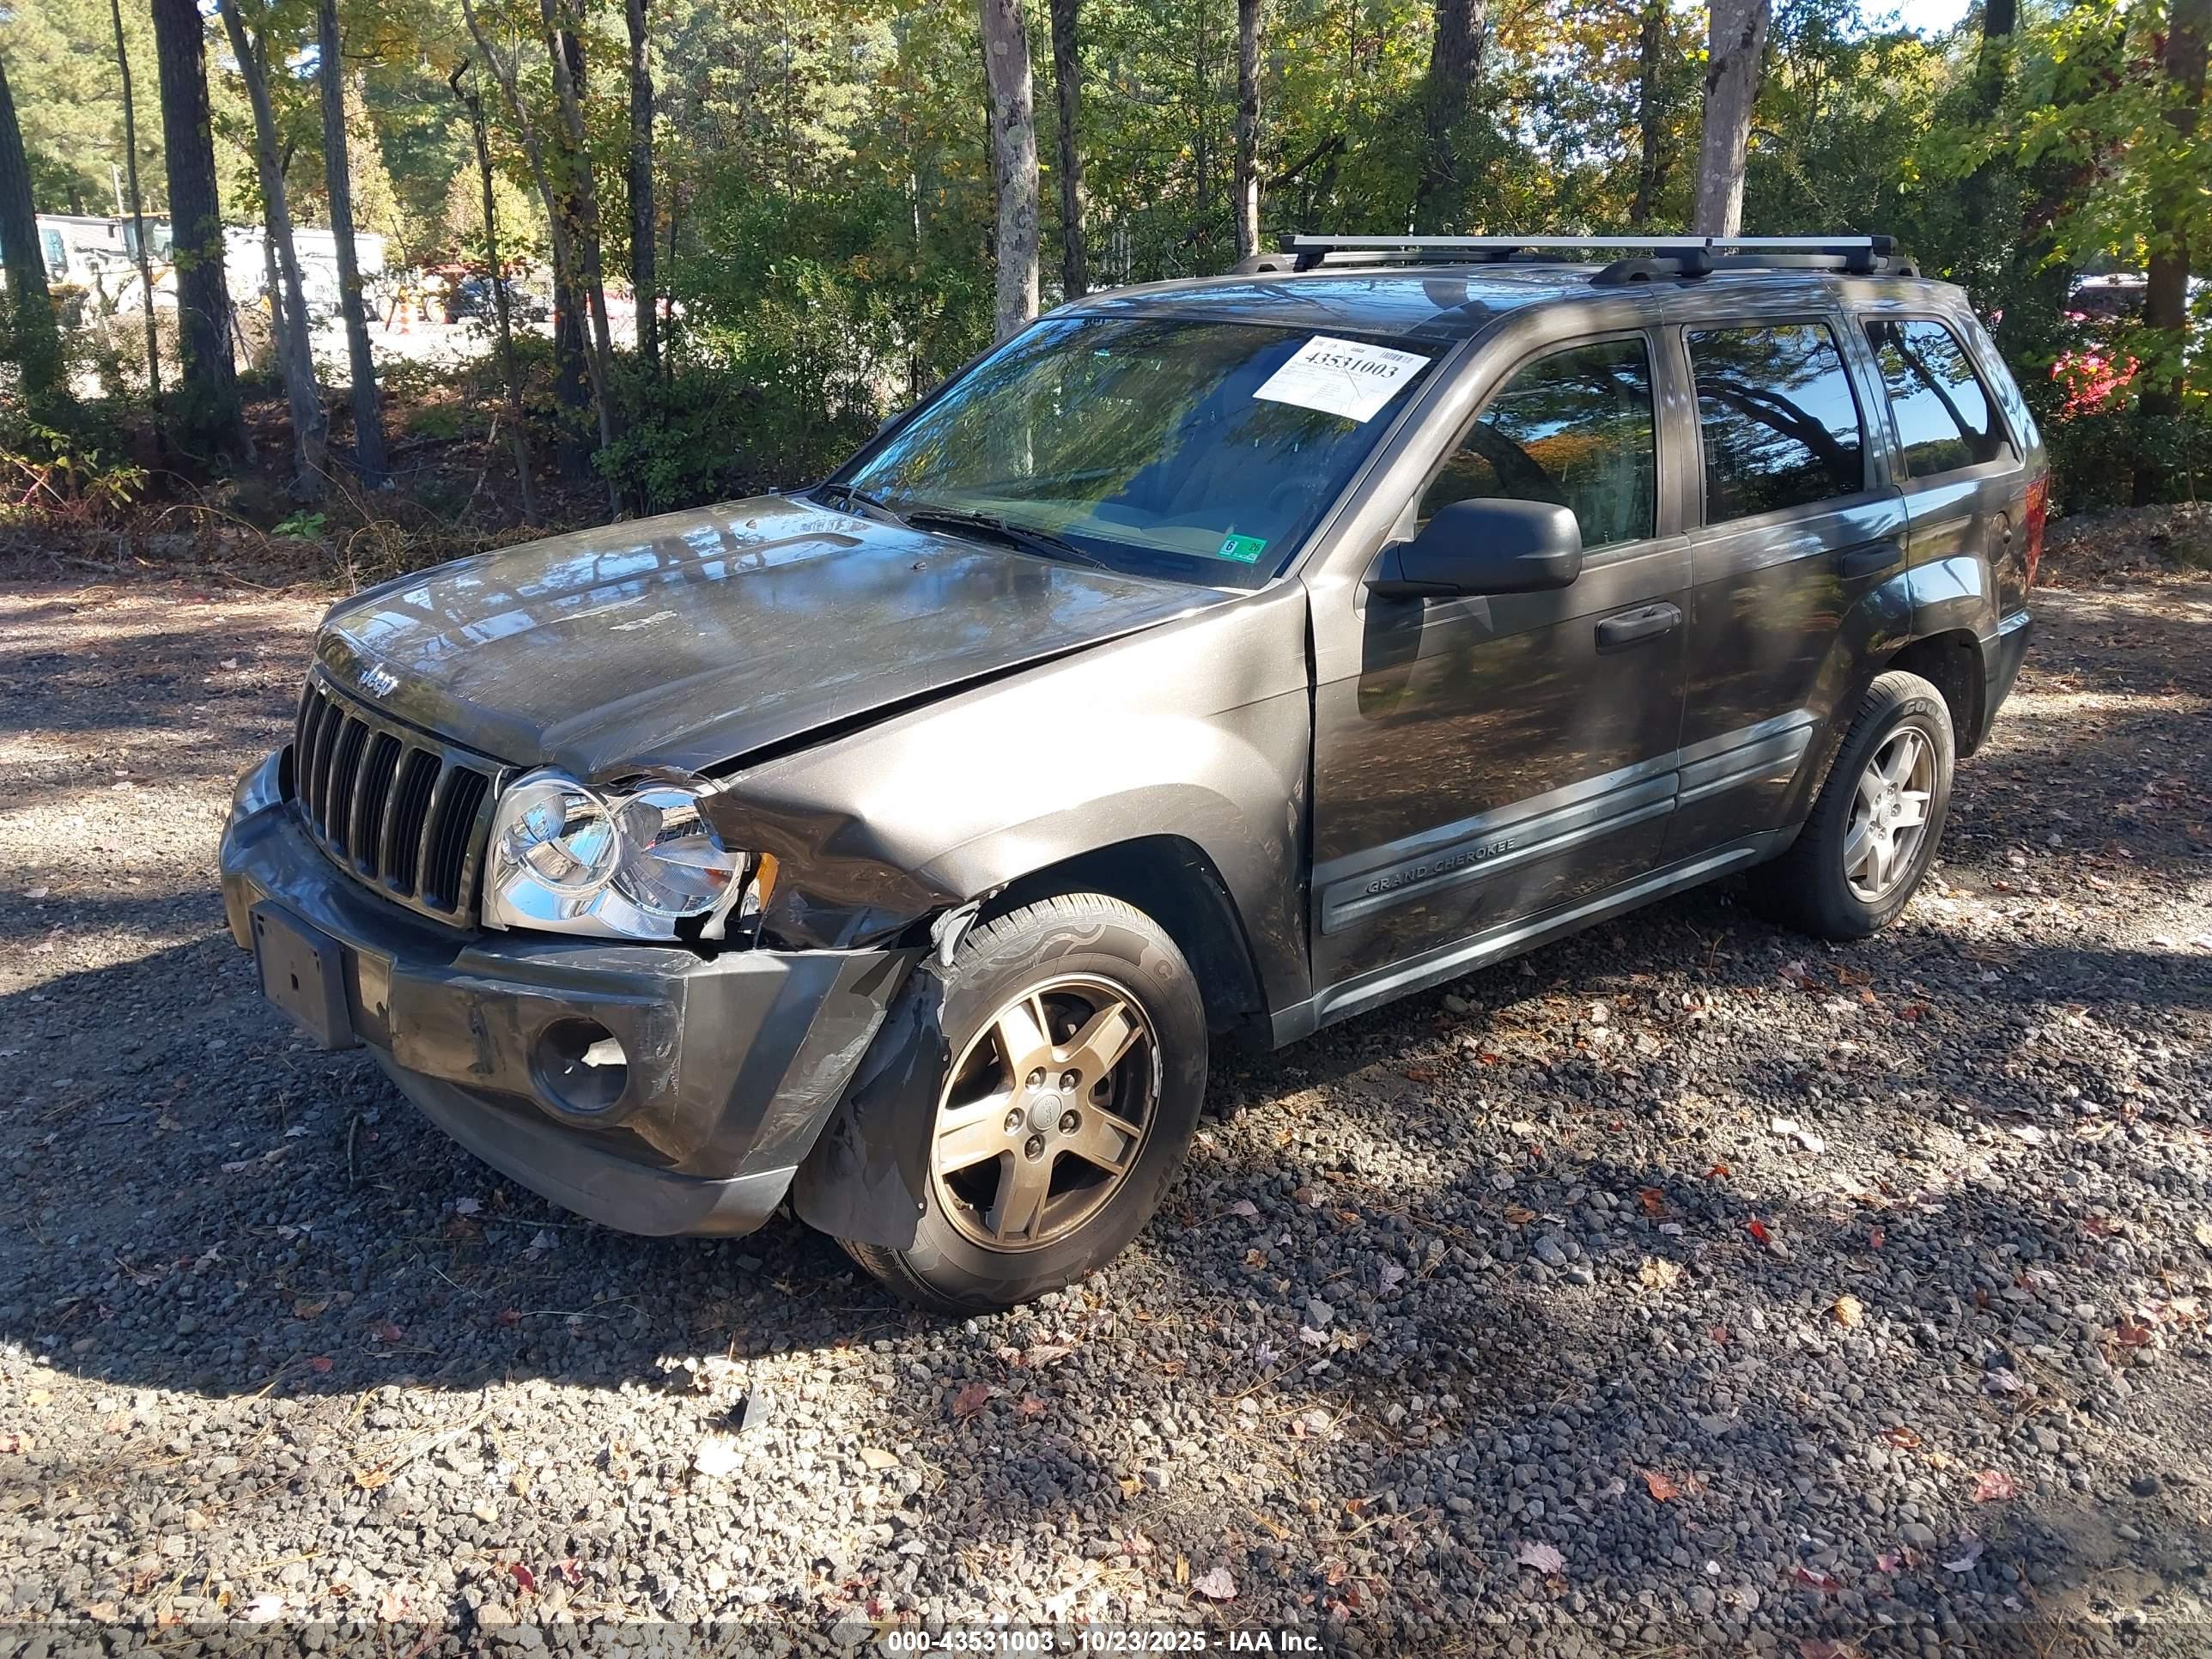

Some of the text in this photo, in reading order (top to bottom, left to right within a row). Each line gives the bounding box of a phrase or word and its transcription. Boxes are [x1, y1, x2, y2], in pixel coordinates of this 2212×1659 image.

[1304, 351, 1399, 379] 43531003
[1226, 542, 1235, 551] 6
[360, 661, 399, 700] Jeep
[1366, 837, 1516, 894] GRAND CHEROKEE
